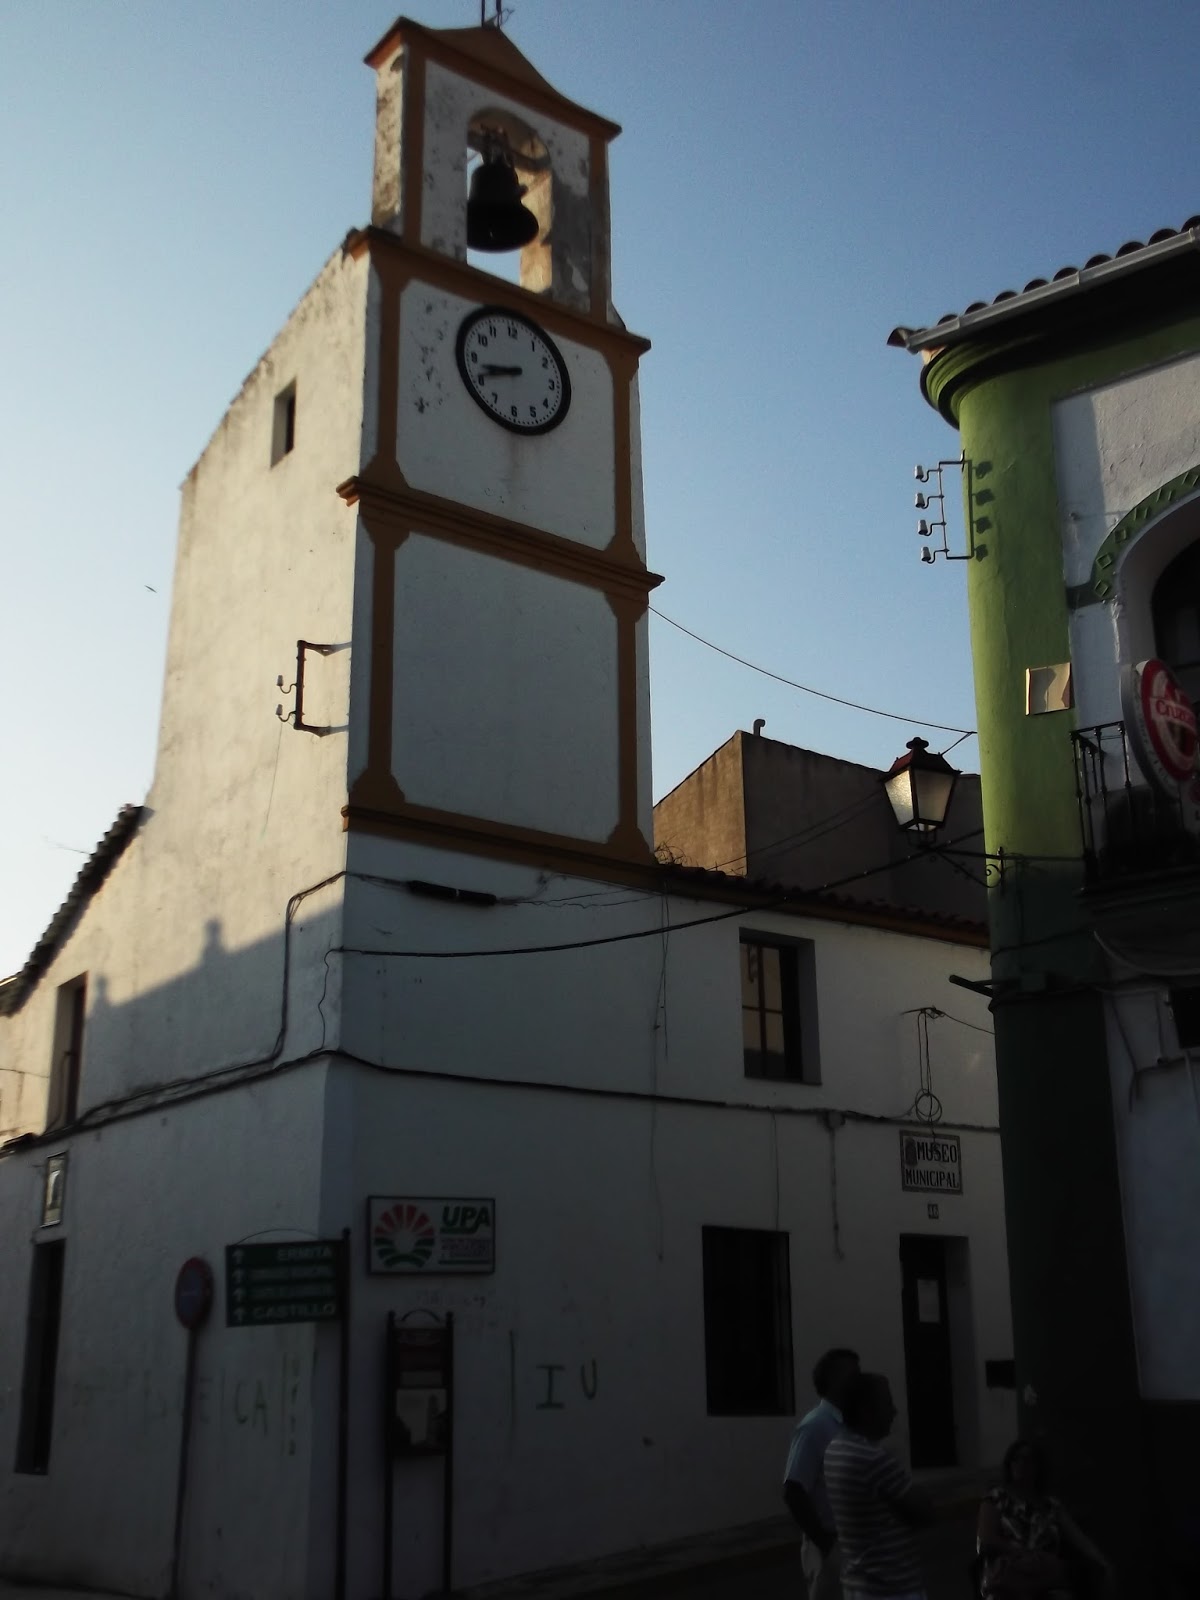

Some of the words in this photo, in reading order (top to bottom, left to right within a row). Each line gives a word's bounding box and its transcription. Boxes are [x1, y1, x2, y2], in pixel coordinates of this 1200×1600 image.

[489, 325, 497, 338] 11
[507, 325, 518, 340] 12
[478, 333, 488, 347] 10
[470, 351, 478, 363] 9
[542, 357, 549, 369] 2
[548, 379, 555, 391] 3
[491, 392, 498, 404] 7
[542, 397, 549, 409] 4
[510, 406, 518, 417] 6
[529, 406, 537, 418] 5
[917, 1141, 958, 1163] MUSEO
[905, 1168, 960, 1189] MUNICIPAL
[441, 1205, 490, 1229] UPA
[277, 1246, 332, 1262] ERMITA
[252, 1303, 336, 1320] CASTILLO
